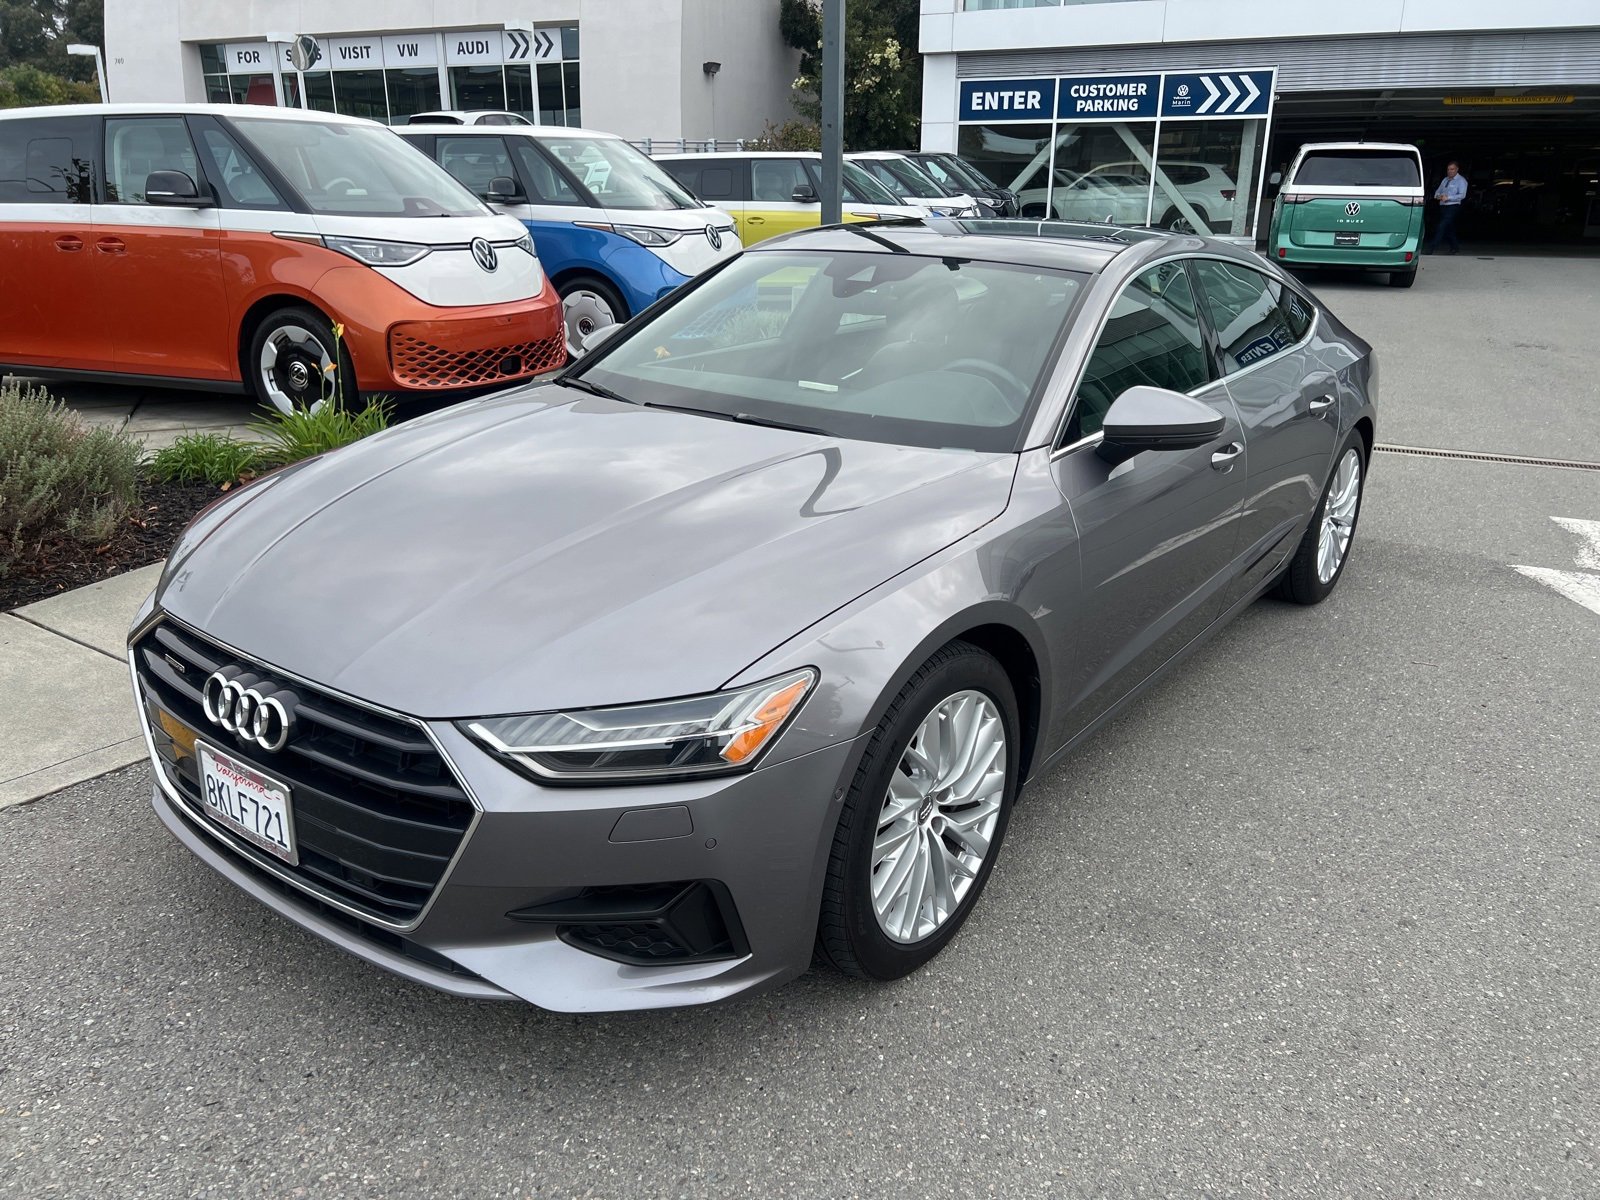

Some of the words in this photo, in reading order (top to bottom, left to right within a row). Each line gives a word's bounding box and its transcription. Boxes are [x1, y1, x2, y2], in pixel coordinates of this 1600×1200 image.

[237, 51, 261, 64] FOR
[339, 45, 371, 60] VISIT
[397, 43, 418, 57] VW
[457, 41, 489, 55] AUDI
[971, 90, 1041, 111] ENTER
[1070, 83, 1147, 98] CUSTOMER
[1076, 98, 1139, 112] PARKING
[206, 773, 288, 848] 8KLF721
